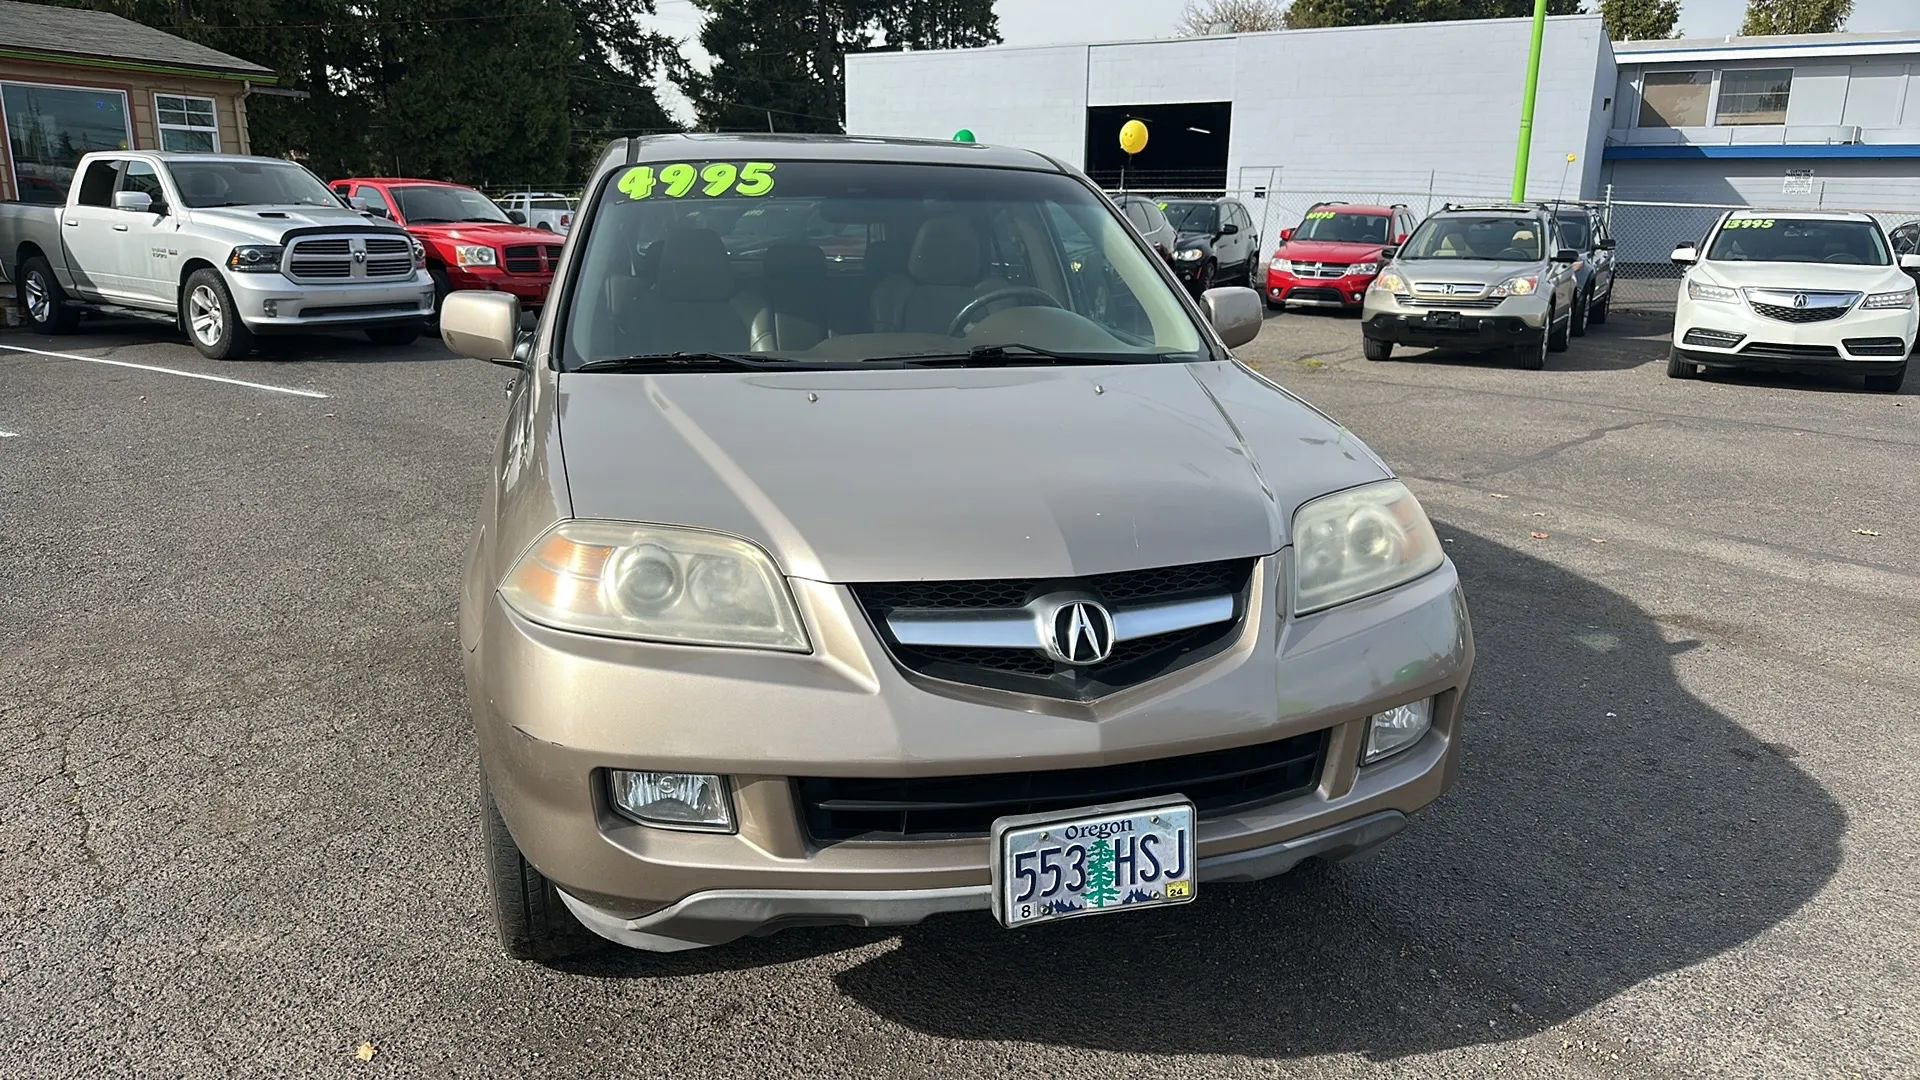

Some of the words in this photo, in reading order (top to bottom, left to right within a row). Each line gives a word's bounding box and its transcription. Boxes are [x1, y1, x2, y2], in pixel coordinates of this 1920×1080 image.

[617, 162, 777, 200] 4995
[1723, 219, 1776, 230] 13995
[1065, 819, 1134, 840] Oregon
[1015, 844, 1087, 902] 553
[1114, 829, 1185, 887] HSJ
[1169, 888, 1184, 897] 24
[1021, 904, 1031, 919] 8
